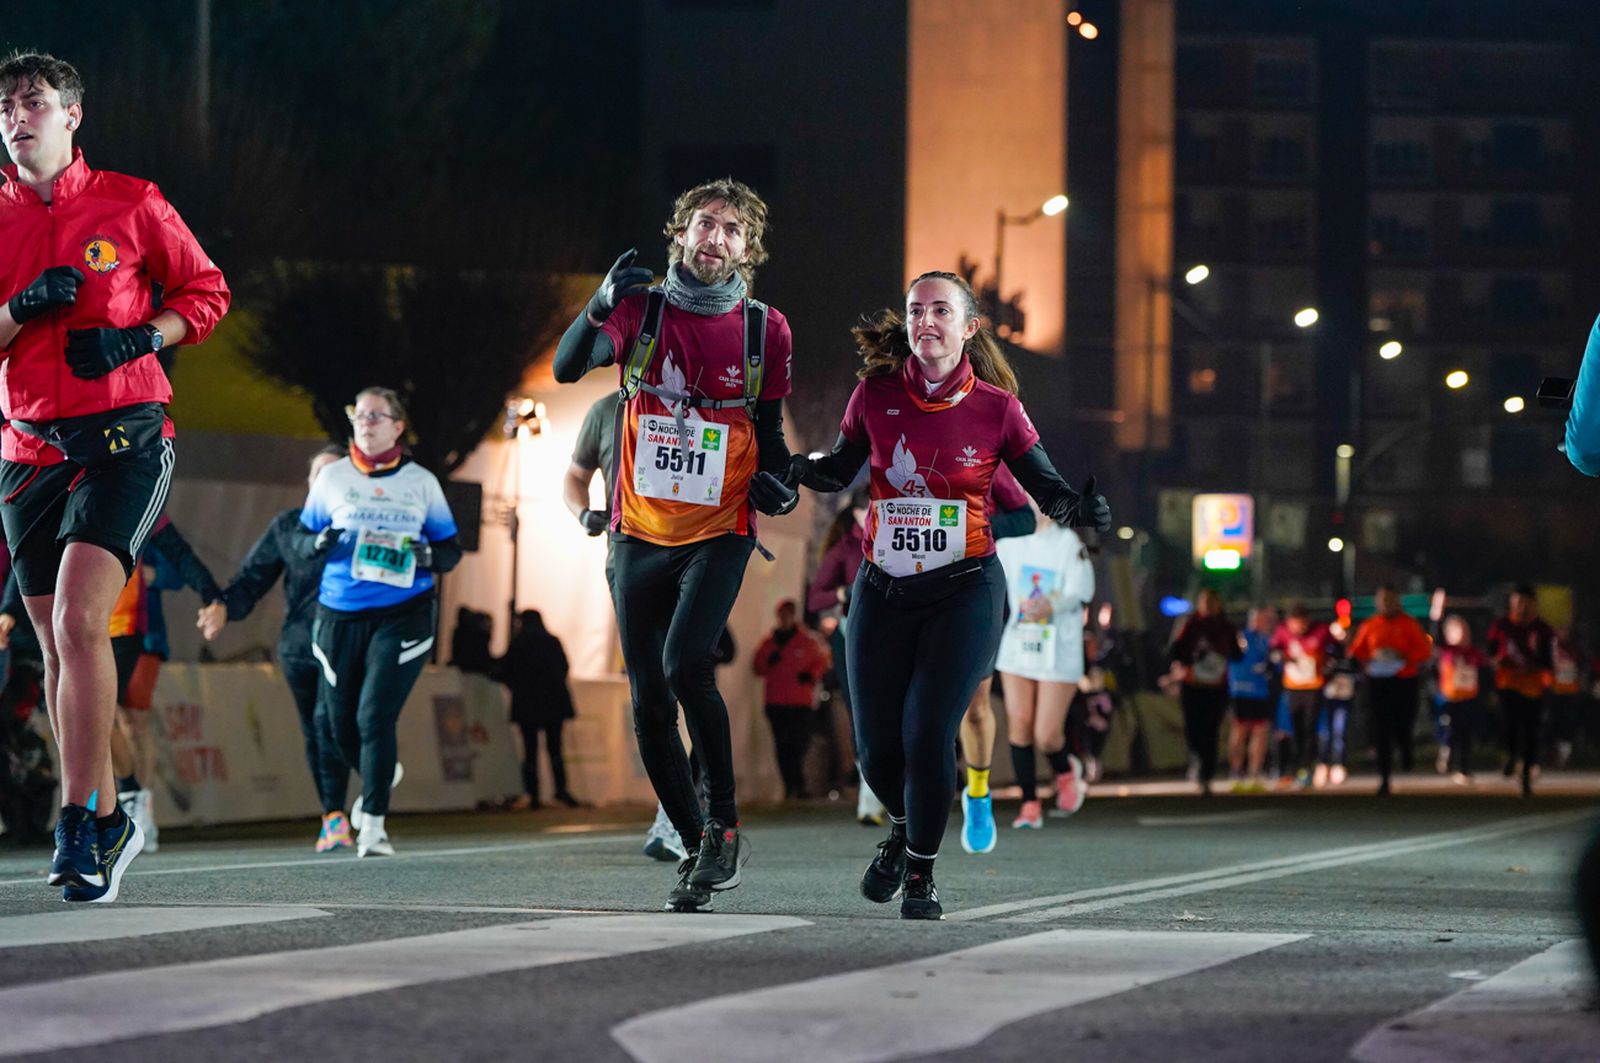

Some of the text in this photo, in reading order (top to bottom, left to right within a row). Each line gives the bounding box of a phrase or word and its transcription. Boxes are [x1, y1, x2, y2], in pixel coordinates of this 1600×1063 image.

[658, 425, 679, 435] NOCH
[648, 434, 665, 445] SAN
[655, 446, 706, 476] 5511
[902, 480, 925, 497] 43
[896, 506, 920, 515] NOCHE
[922, 508, 932, 516] DE
[888, 516, 901, 525] SAN
[891, 527, 947, 552] 5510
